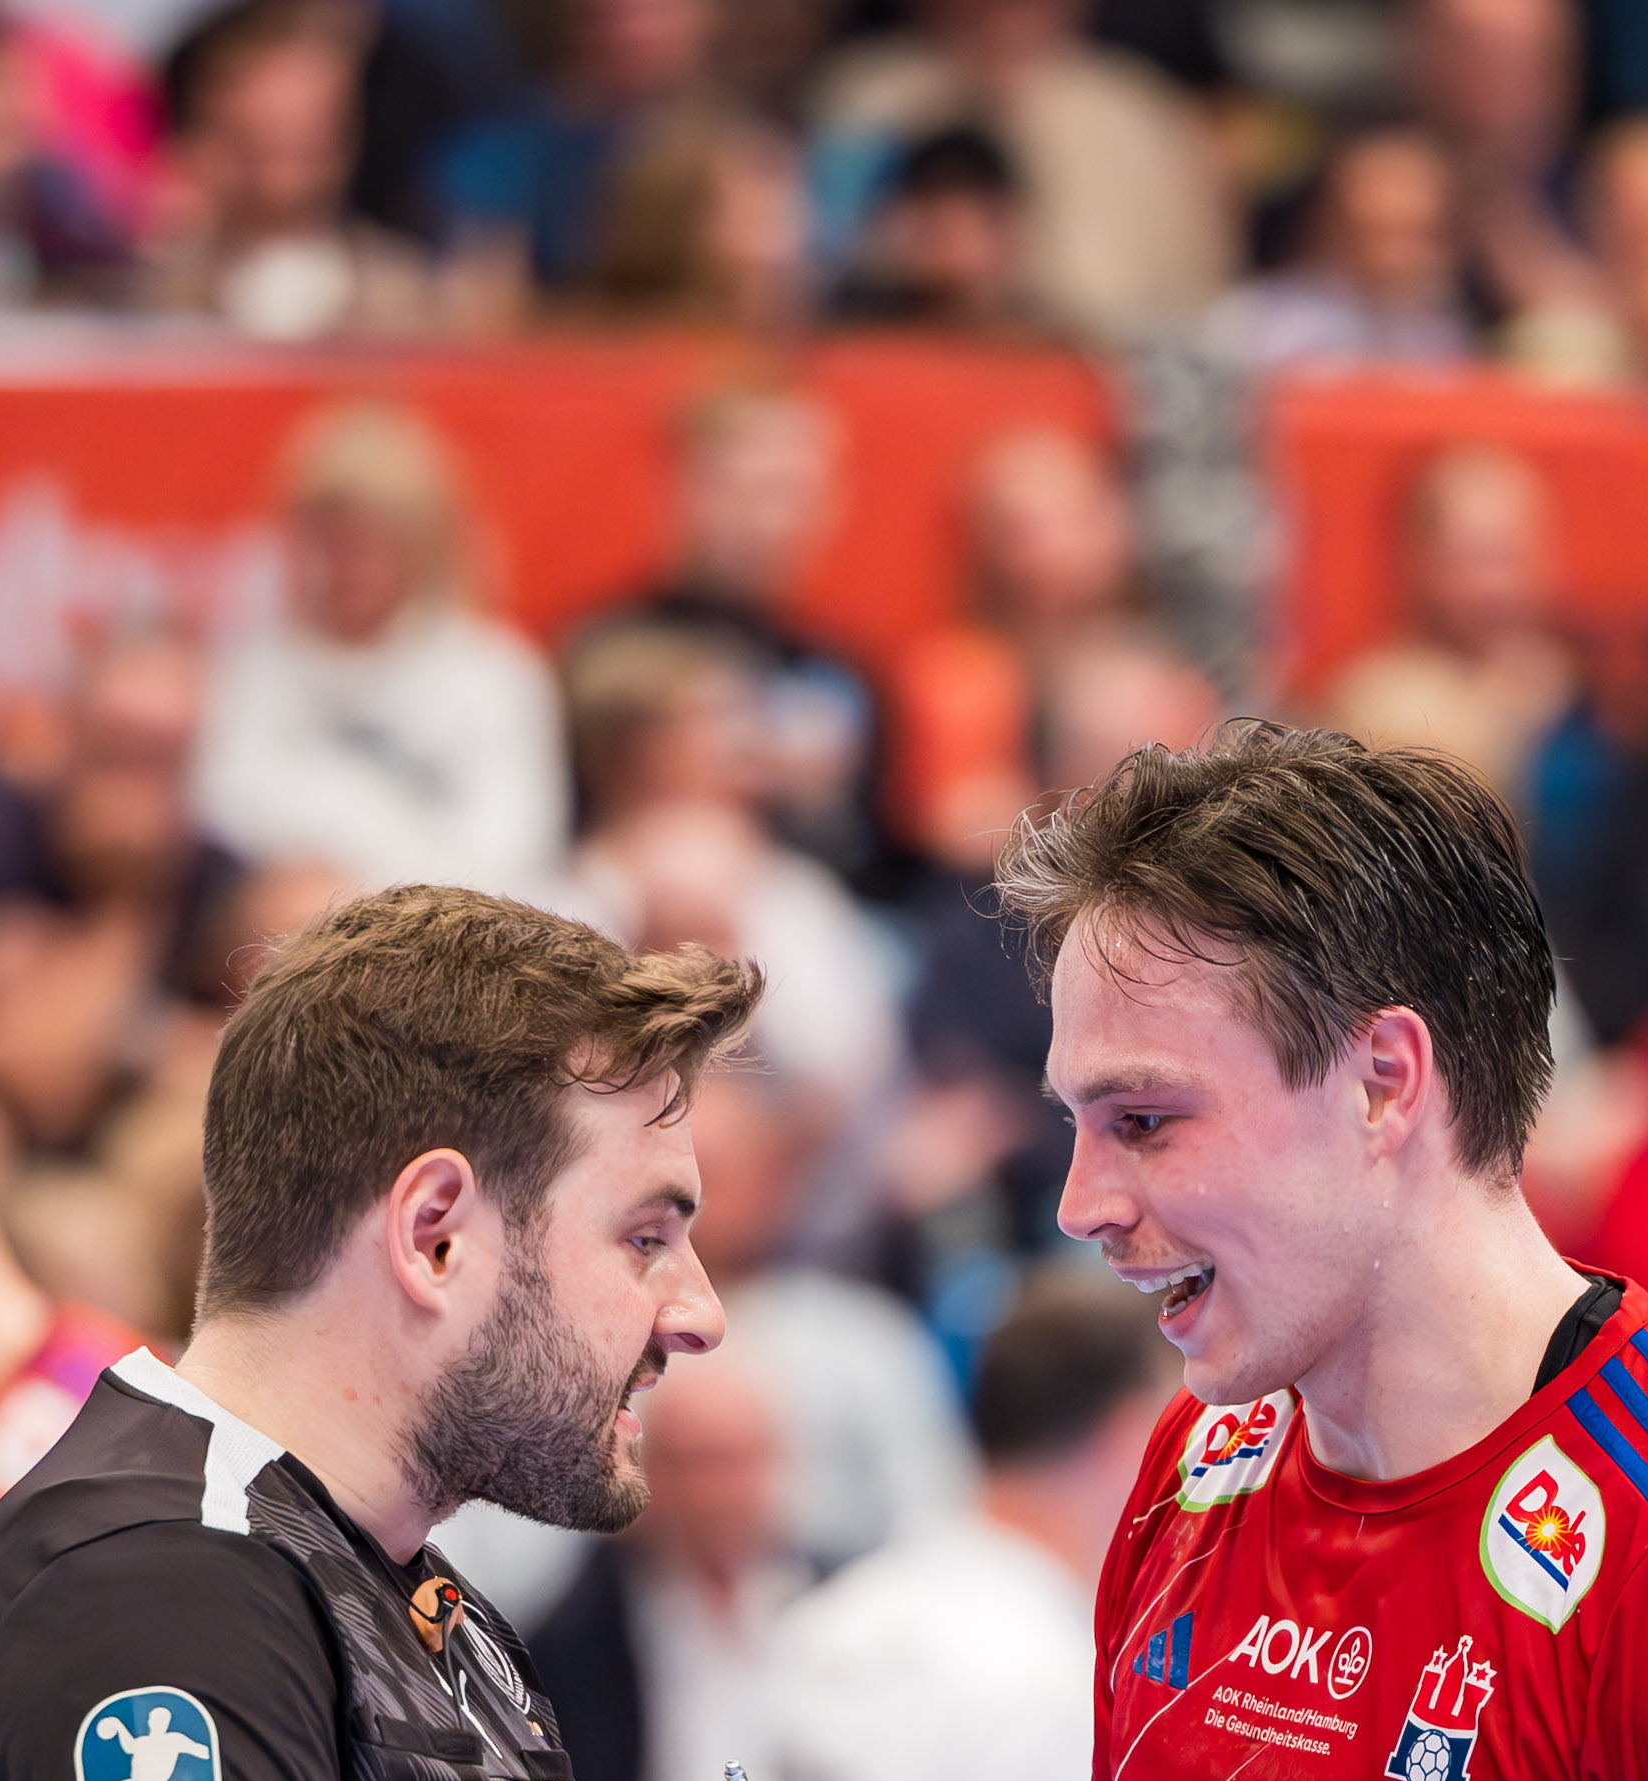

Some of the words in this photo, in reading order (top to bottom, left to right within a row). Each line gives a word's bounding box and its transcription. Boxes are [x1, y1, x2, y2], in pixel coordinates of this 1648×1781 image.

[1200, 1396, 1277, 1464] Dole
[1505, 1469, 1587, 1577] Dole
[1228, 1614, 1332, 1684] AOK
[1205, 1708, 1225, 1728] Die
[1225, 1714, 1331, 1756] Gesundheitskasse.
[1212, 1685, 1242, 1706] AOK
[1241, 1692, 1358, 1740] Rheinland/Hamburg
